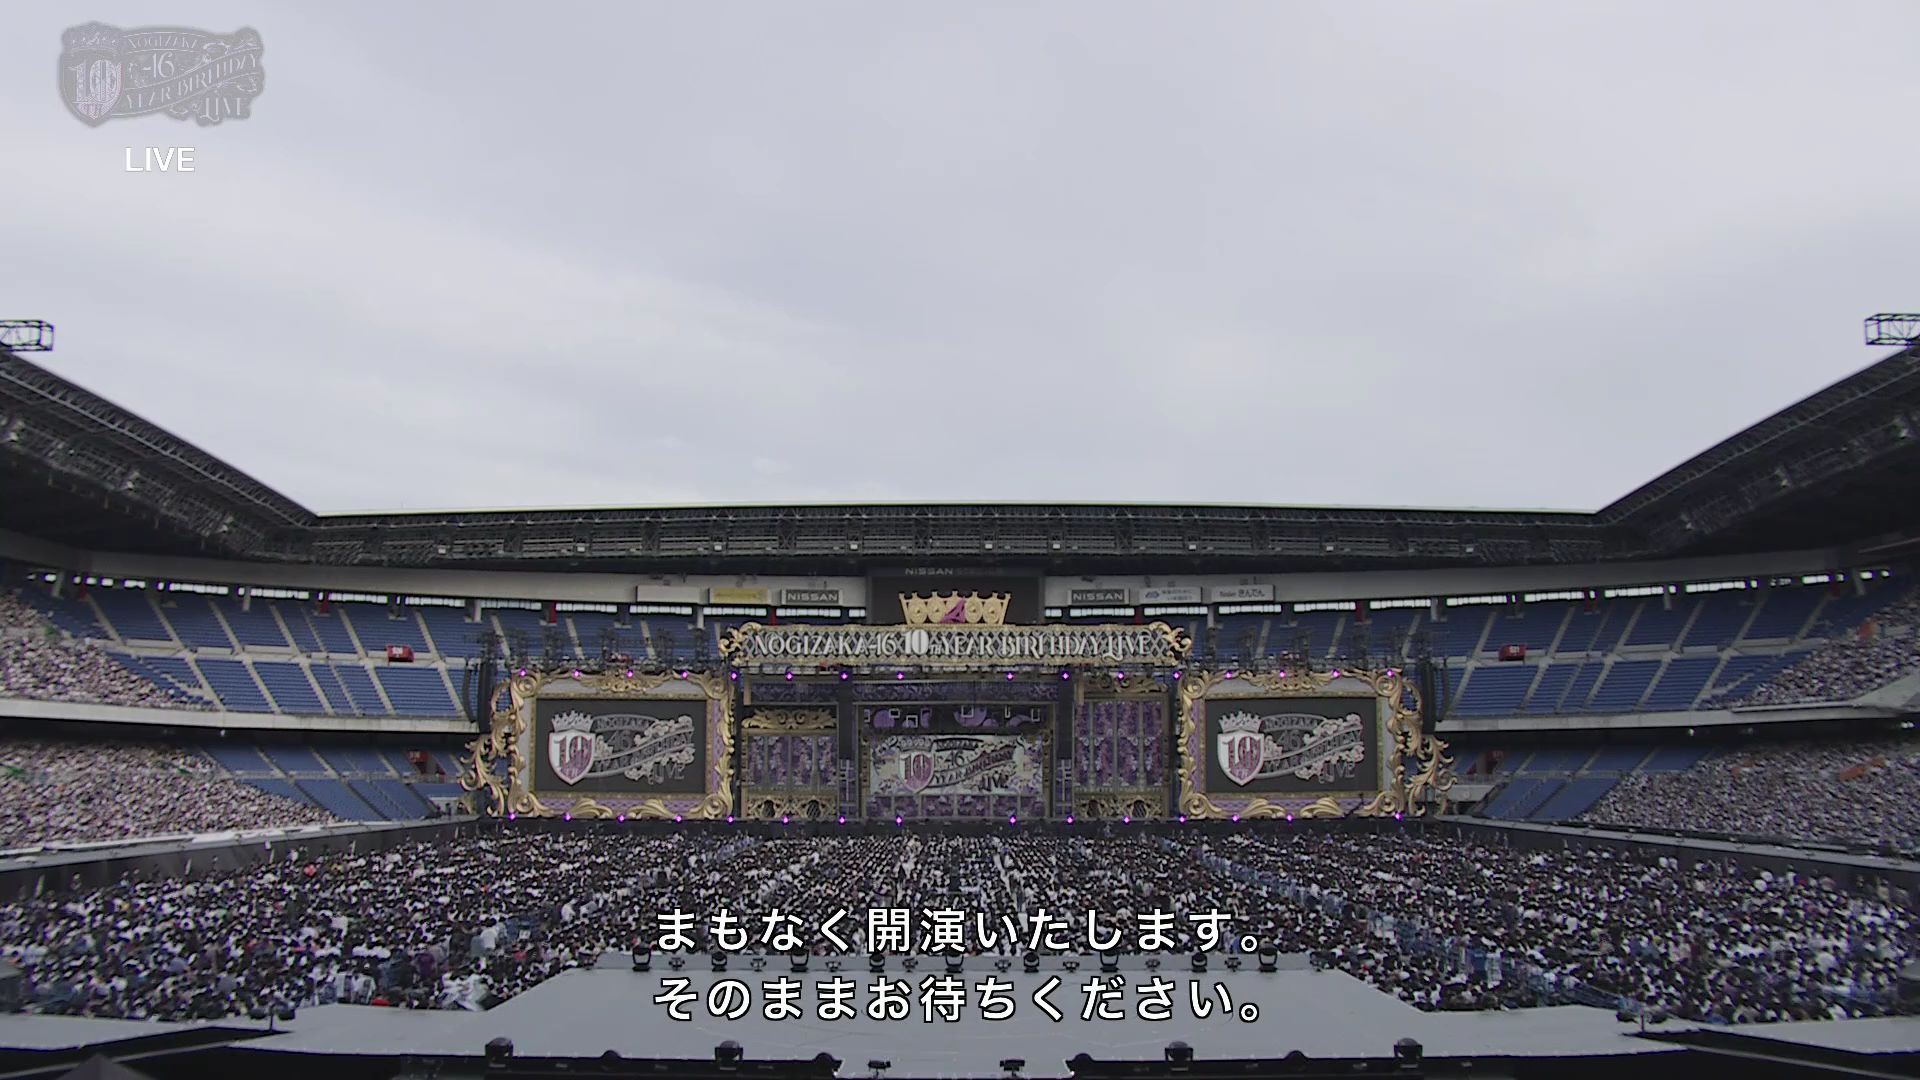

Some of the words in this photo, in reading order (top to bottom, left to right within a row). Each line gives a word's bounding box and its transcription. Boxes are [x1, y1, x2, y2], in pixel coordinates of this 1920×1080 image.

[904, 567, 954, 576] NISSAN
[786, 592, 839, 602] NISSAN
[1072, 591, 1124, 602] NISSAN
[941, 634, 993, 656] YEAR
[1000, 634, 1100, 660] BIRTHDAY
[1102, 634, 1152, 662] LIVE
